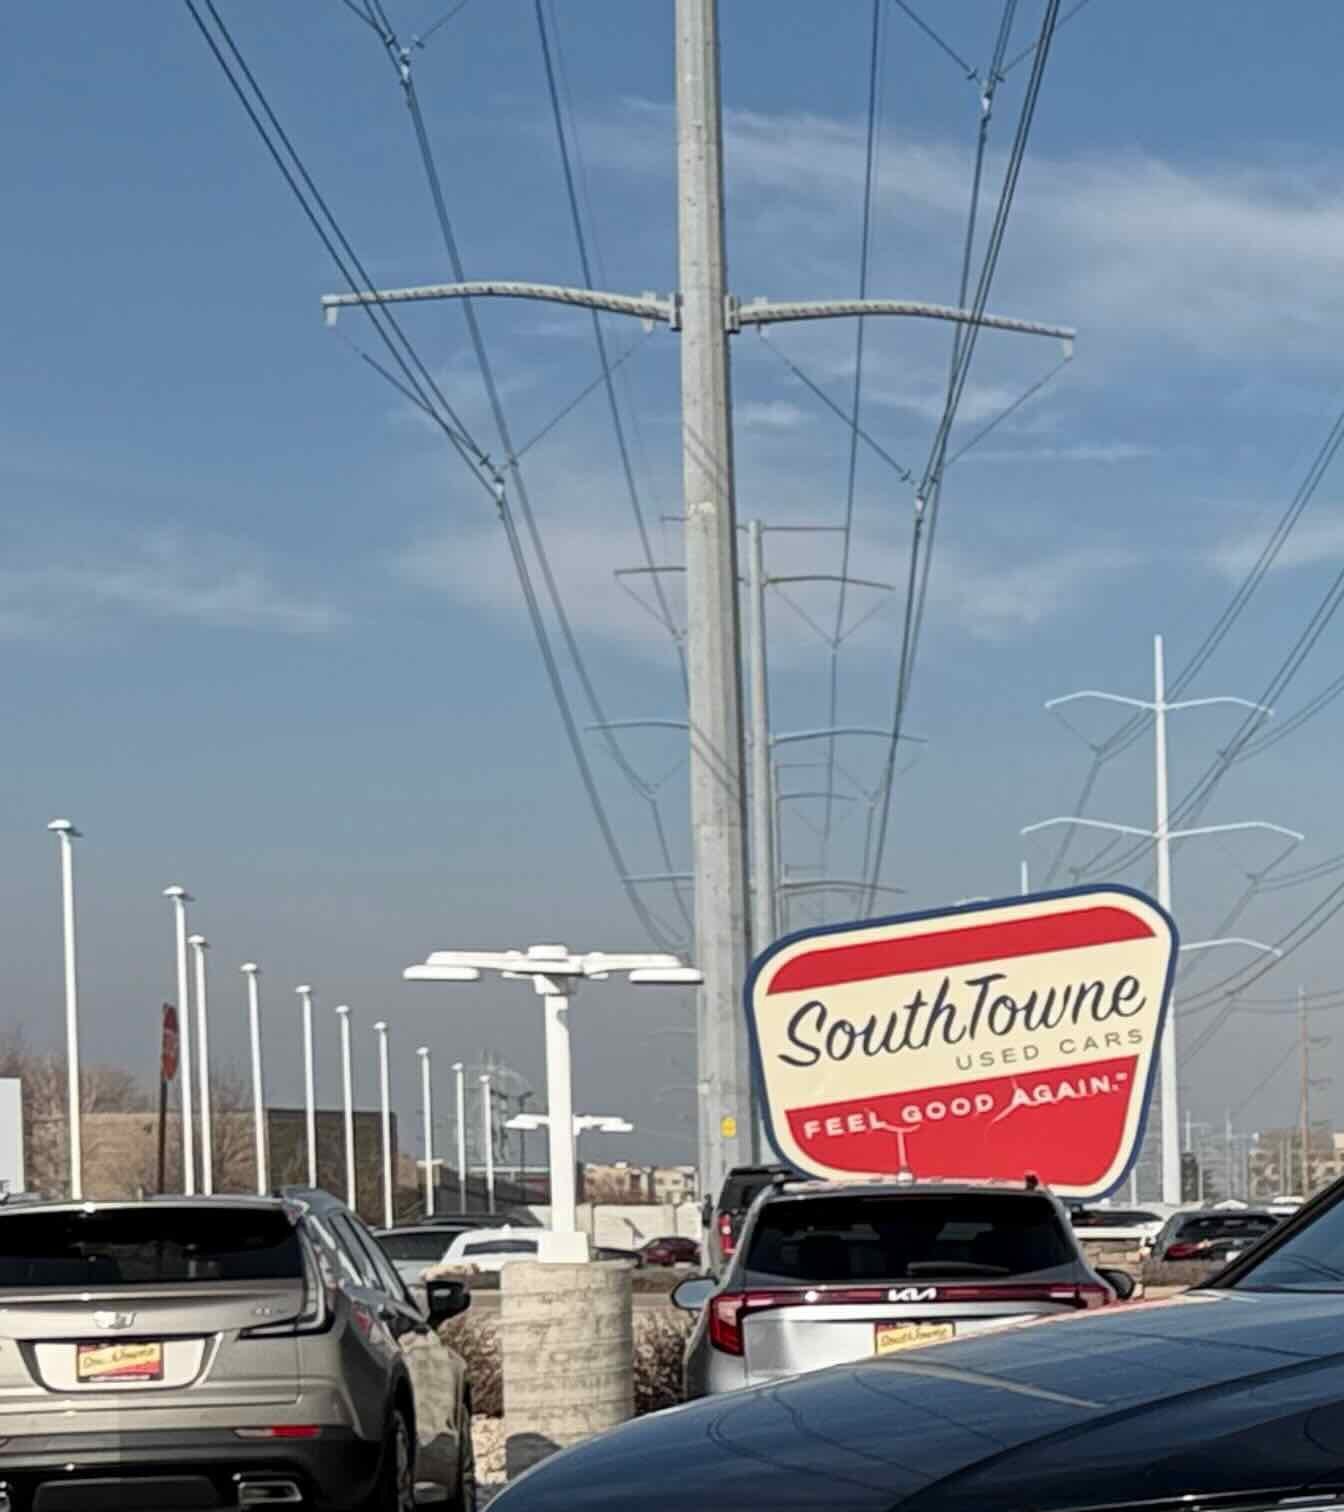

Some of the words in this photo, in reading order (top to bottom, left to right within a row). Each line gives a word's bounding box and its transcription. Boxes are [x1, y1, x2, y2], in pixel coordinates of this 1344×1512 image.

[779, 974, 1146, 1067] SouthTowne
[955, 1045, 1040, 1072] USED
[1058, 1028, 1144, 1055] CARS
[803, 1110, 887, 1141] FEEL
[901, 1093, 995, 1123] GOOD
